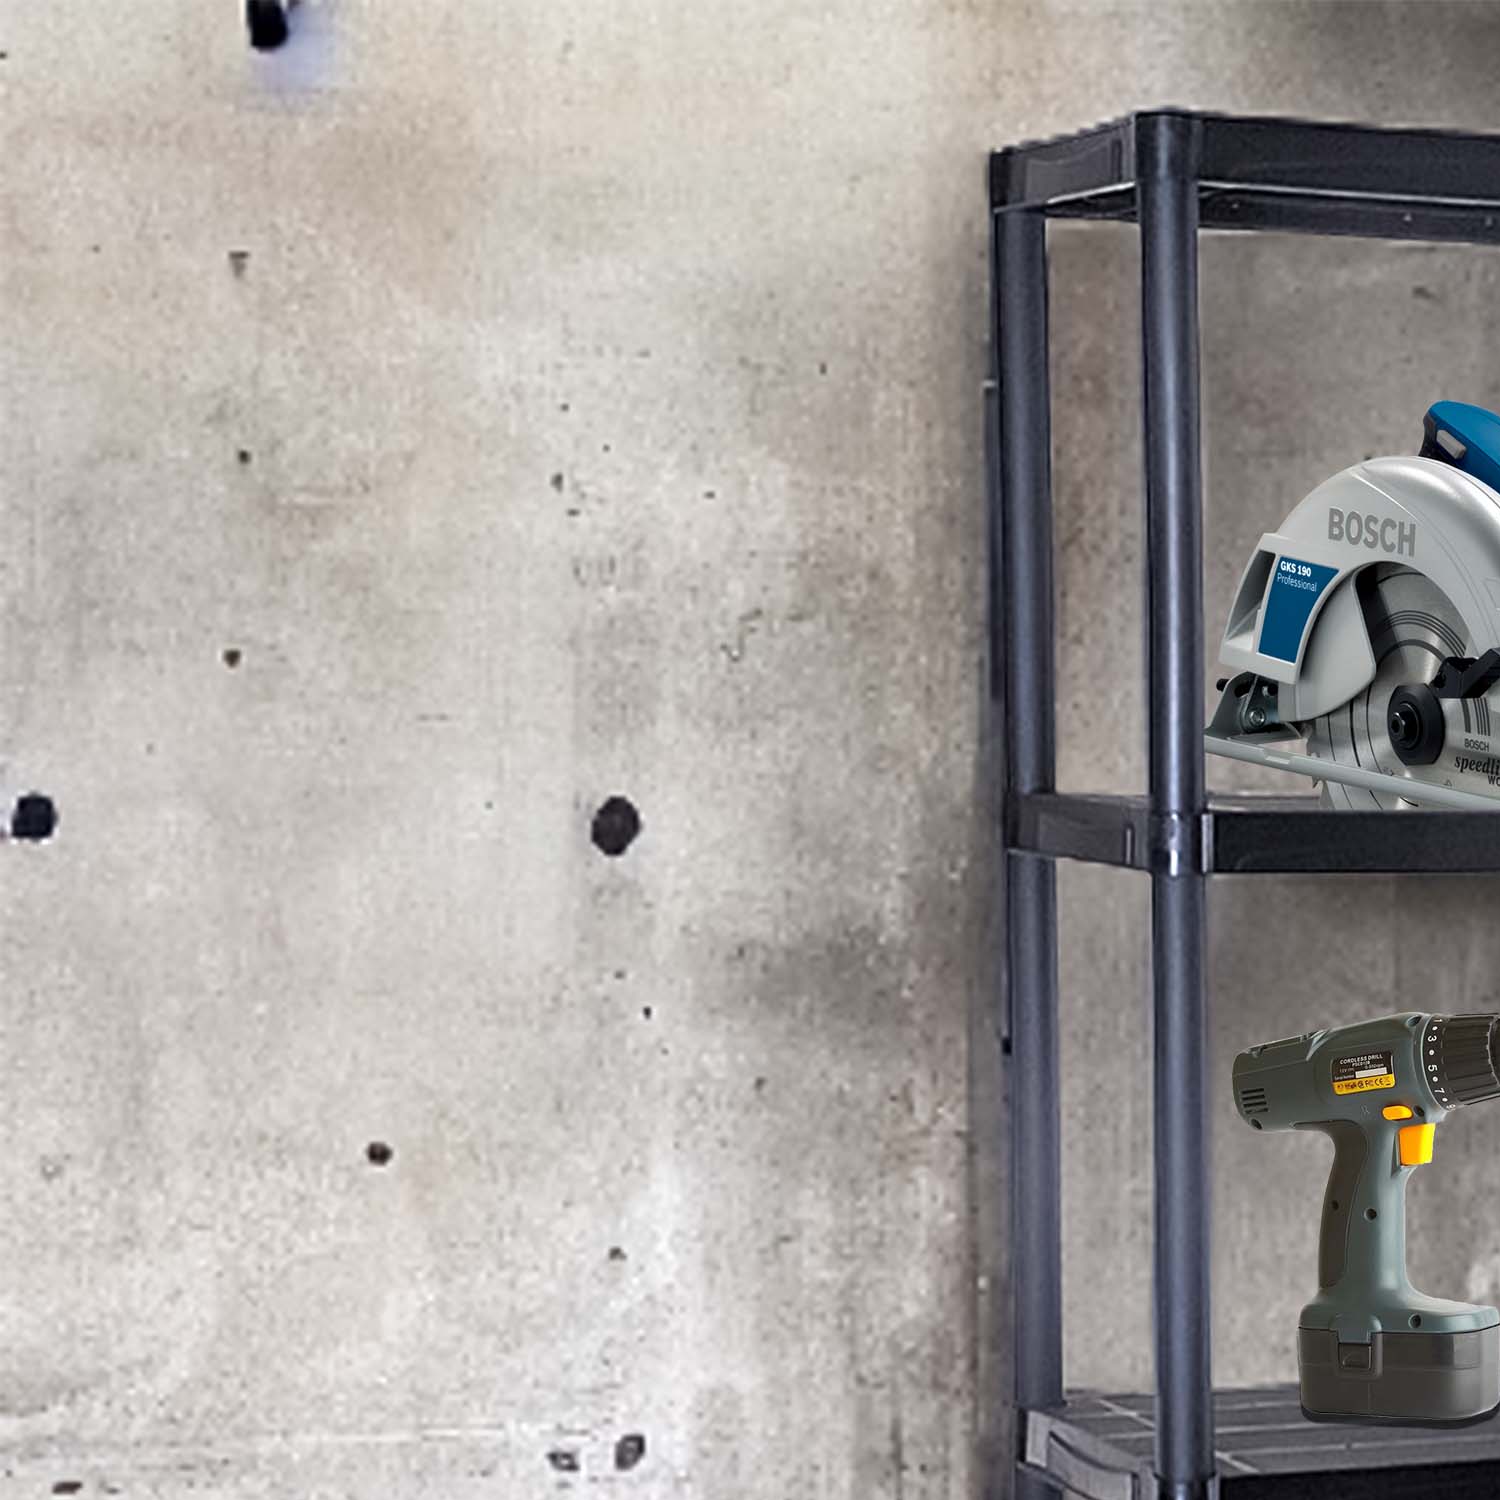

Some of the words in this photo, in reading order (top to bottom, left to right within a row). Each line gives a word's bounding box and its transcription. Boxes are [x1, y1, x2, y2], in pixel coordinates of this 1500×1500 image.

[1327, 508, 1416, 557] BOSCH
[1280, 561, 1296, 573] GKS
[1297, 565, 1312, 577] 190
[1277, 572, 1317, 592] Professional
[1464, 738, 1490, 752] BOSCH
[1340, 1055, 1367, 1065] CORDLESS
[1368, 1053, 1383, 1061] DRILL
[1428, 1064, 1438, 1072] 5
